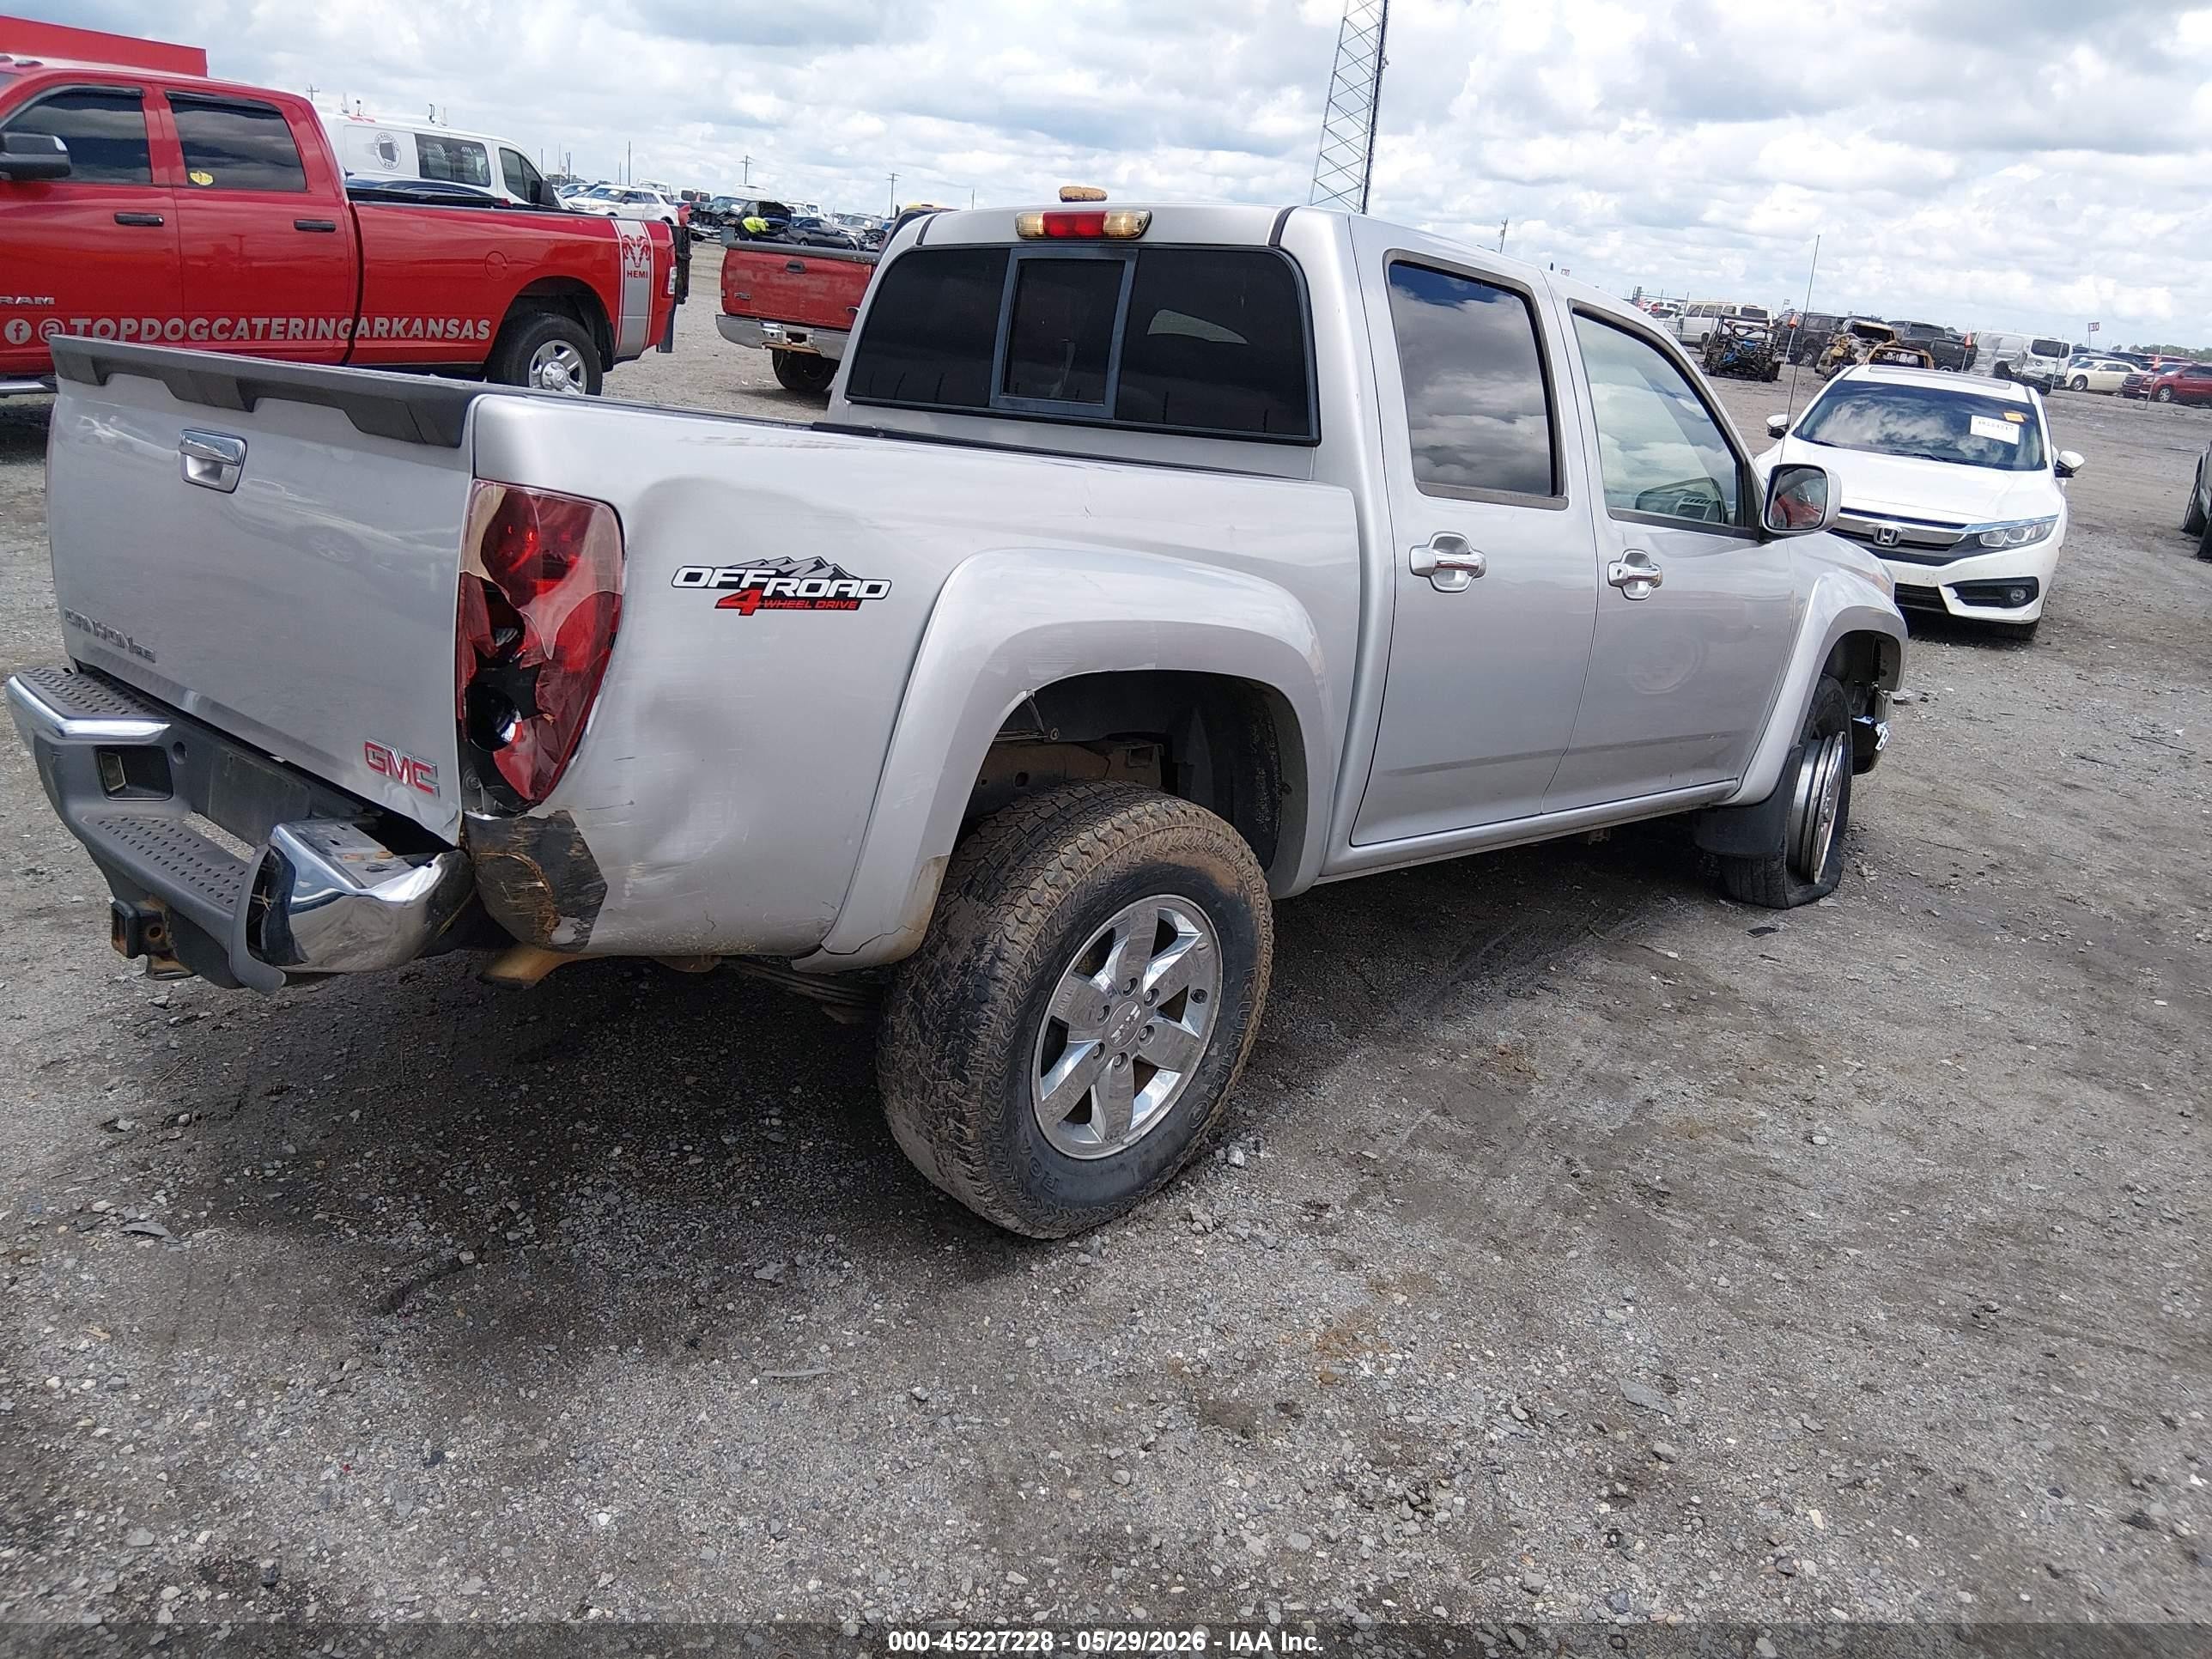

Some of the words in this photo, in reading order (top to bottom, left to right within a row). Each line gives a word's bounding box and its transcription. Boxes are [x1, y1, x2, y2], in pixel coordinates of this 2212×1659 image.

[627, 270, 648, 279] HEMI
[0, 295, 55, 305] RAM
[715, 589, 763, 616] 4
[763, 599, 811, 609] WHEEL
[815, 600, 859, 610] DRIVE
[365, 738, 440, 797] GMC
[1188, 967, 1257, 1129] KUMHO
